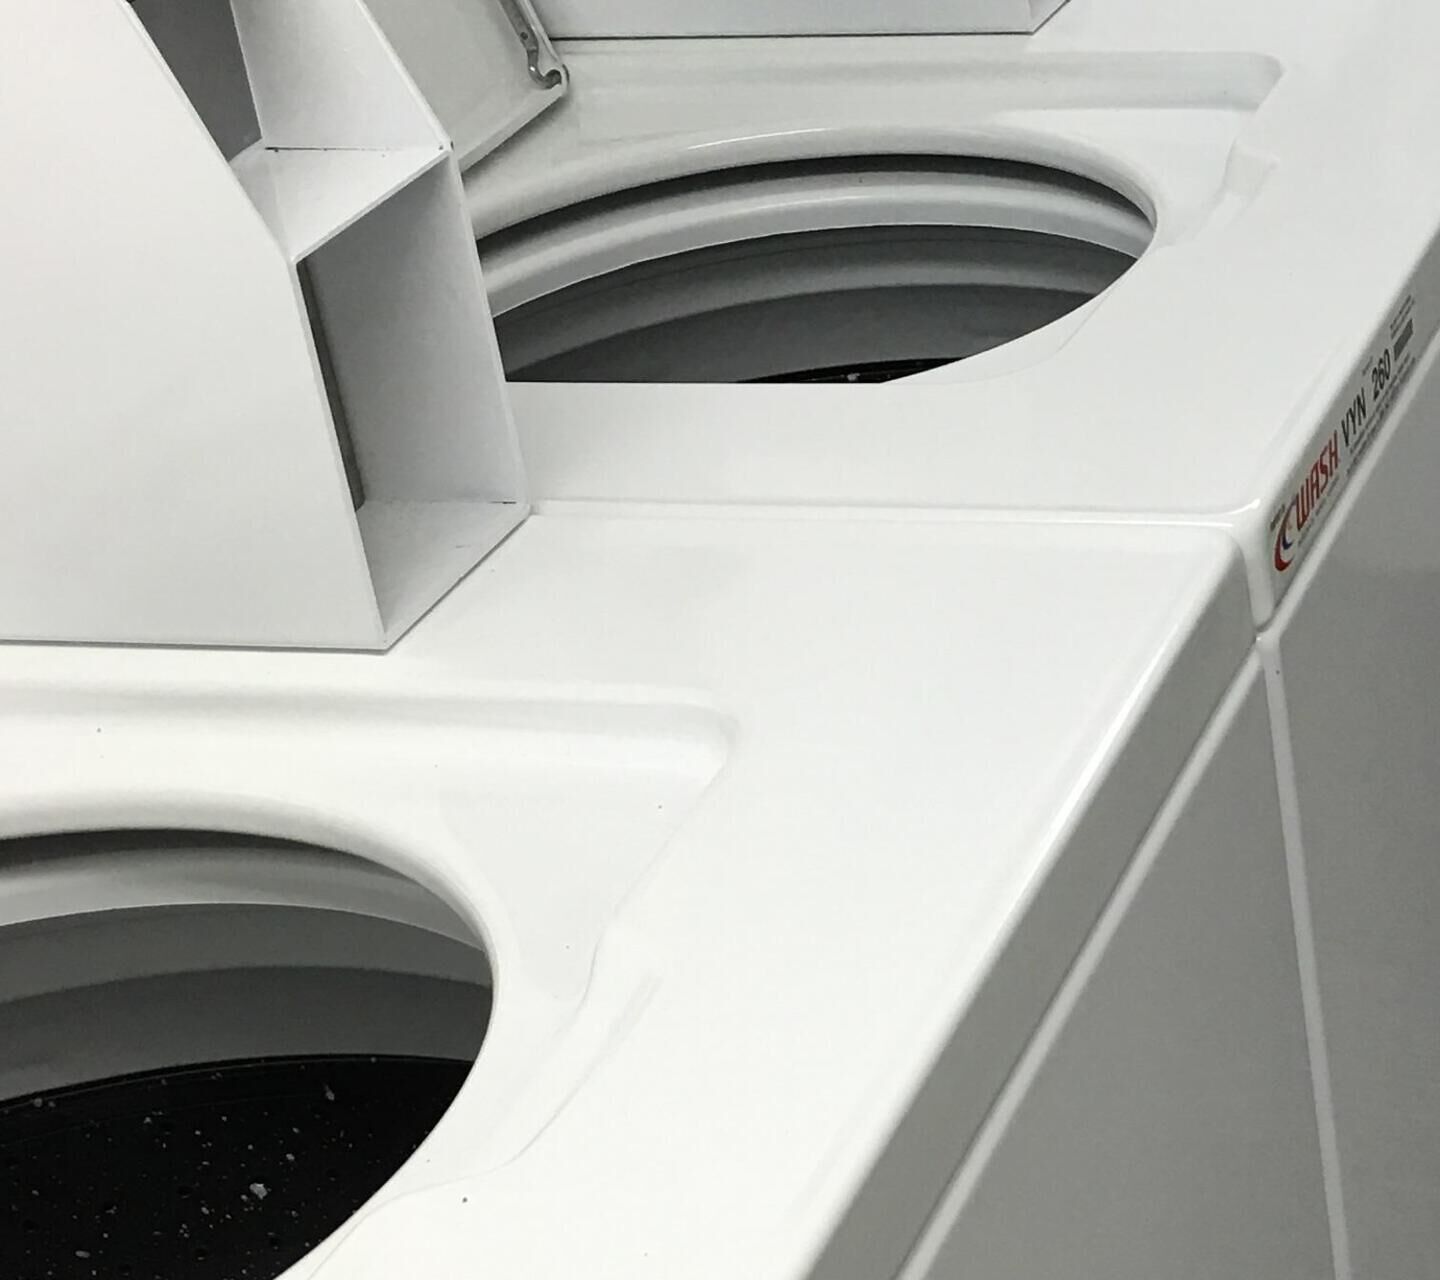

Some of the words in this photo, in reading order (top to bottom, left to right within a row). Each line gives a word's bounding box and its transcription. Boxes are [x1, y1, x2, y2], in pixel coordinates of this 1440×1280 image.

[1295, 429, 1339, 532] WASH
[1341, 387, 1367, 447] VYN
[1371, 348, 1391, 401] 260
